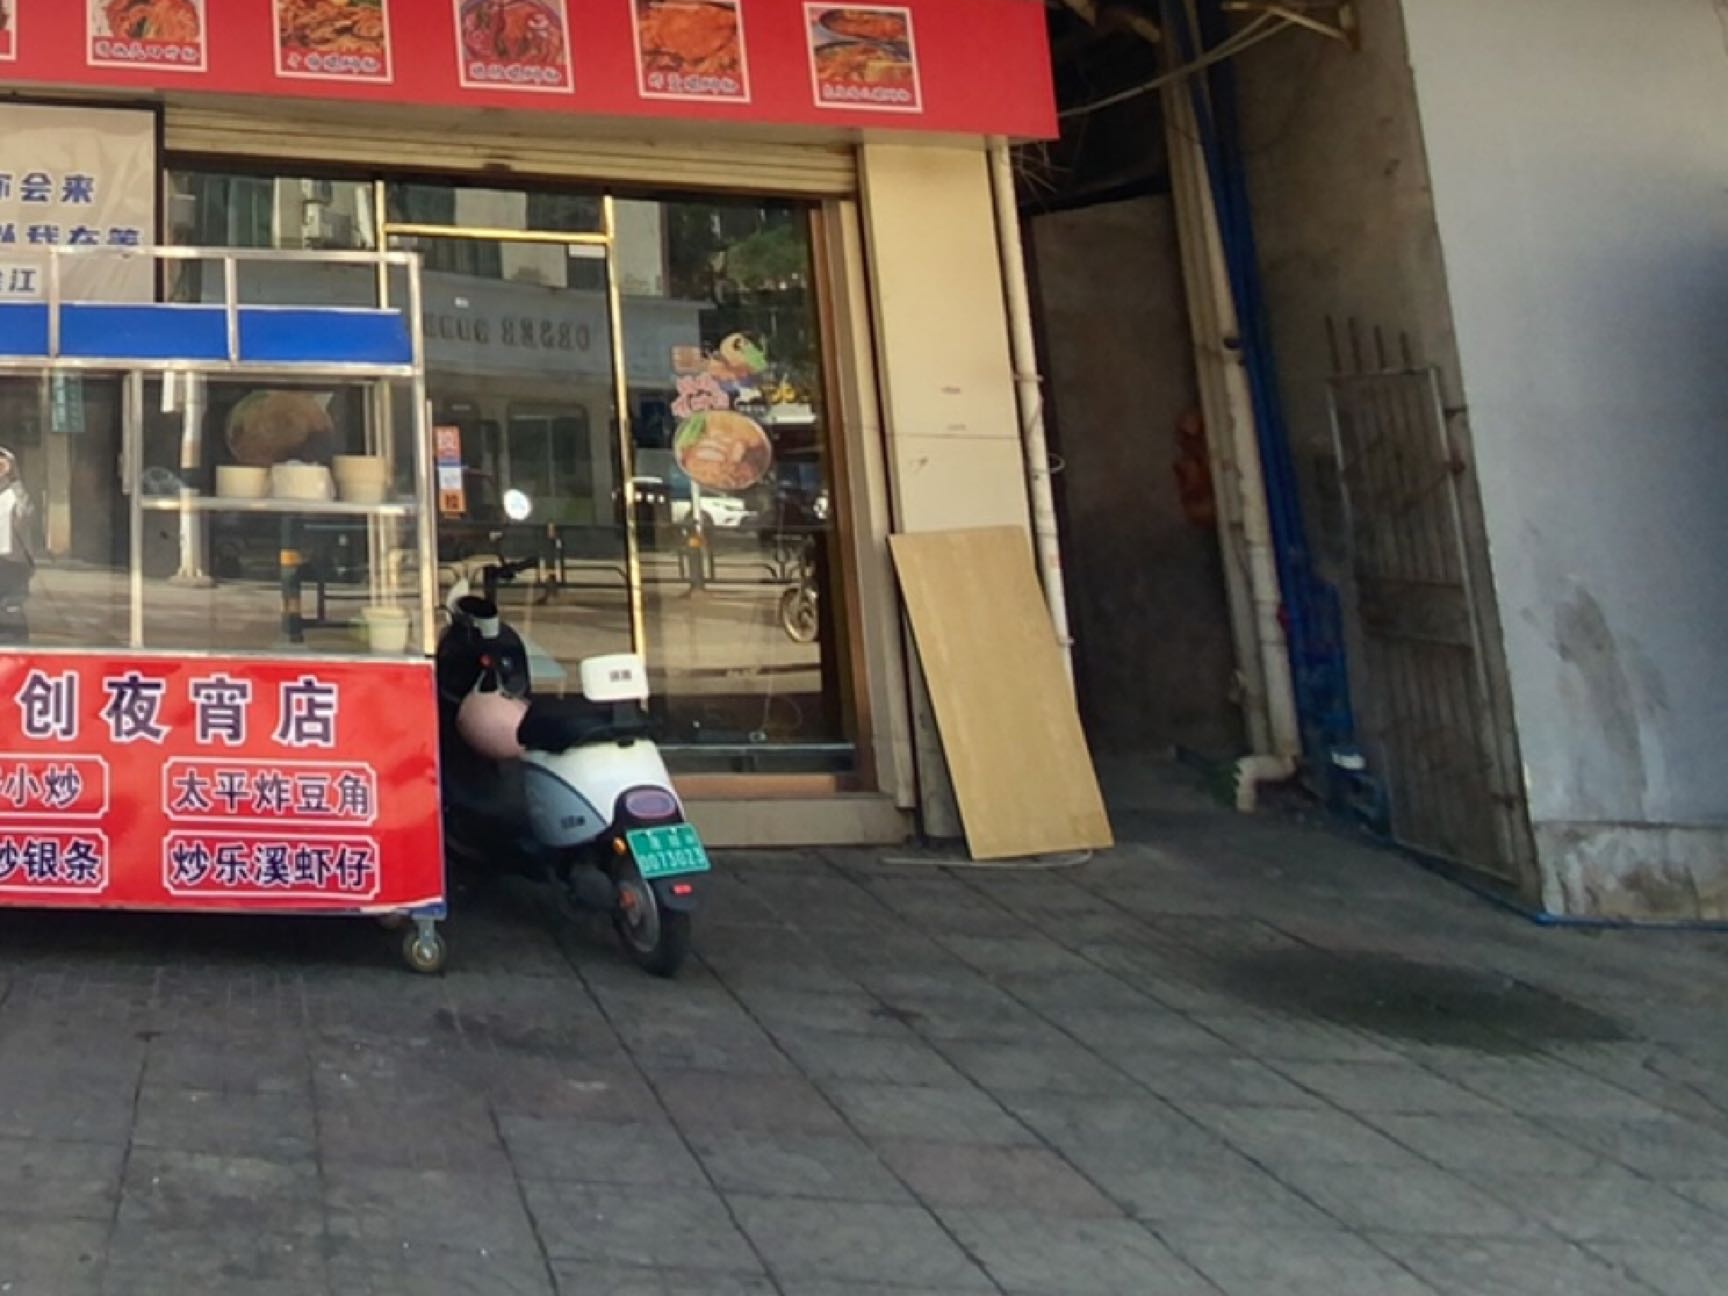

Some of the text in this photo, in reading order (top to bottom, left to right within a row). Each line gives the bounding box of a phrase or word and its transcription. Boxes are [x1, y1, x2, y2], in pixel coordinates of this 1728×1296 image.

[173, 769, 371, 816] 太平炸豆角
[170, 840, 374, 889] 炒乐溪虾仔
